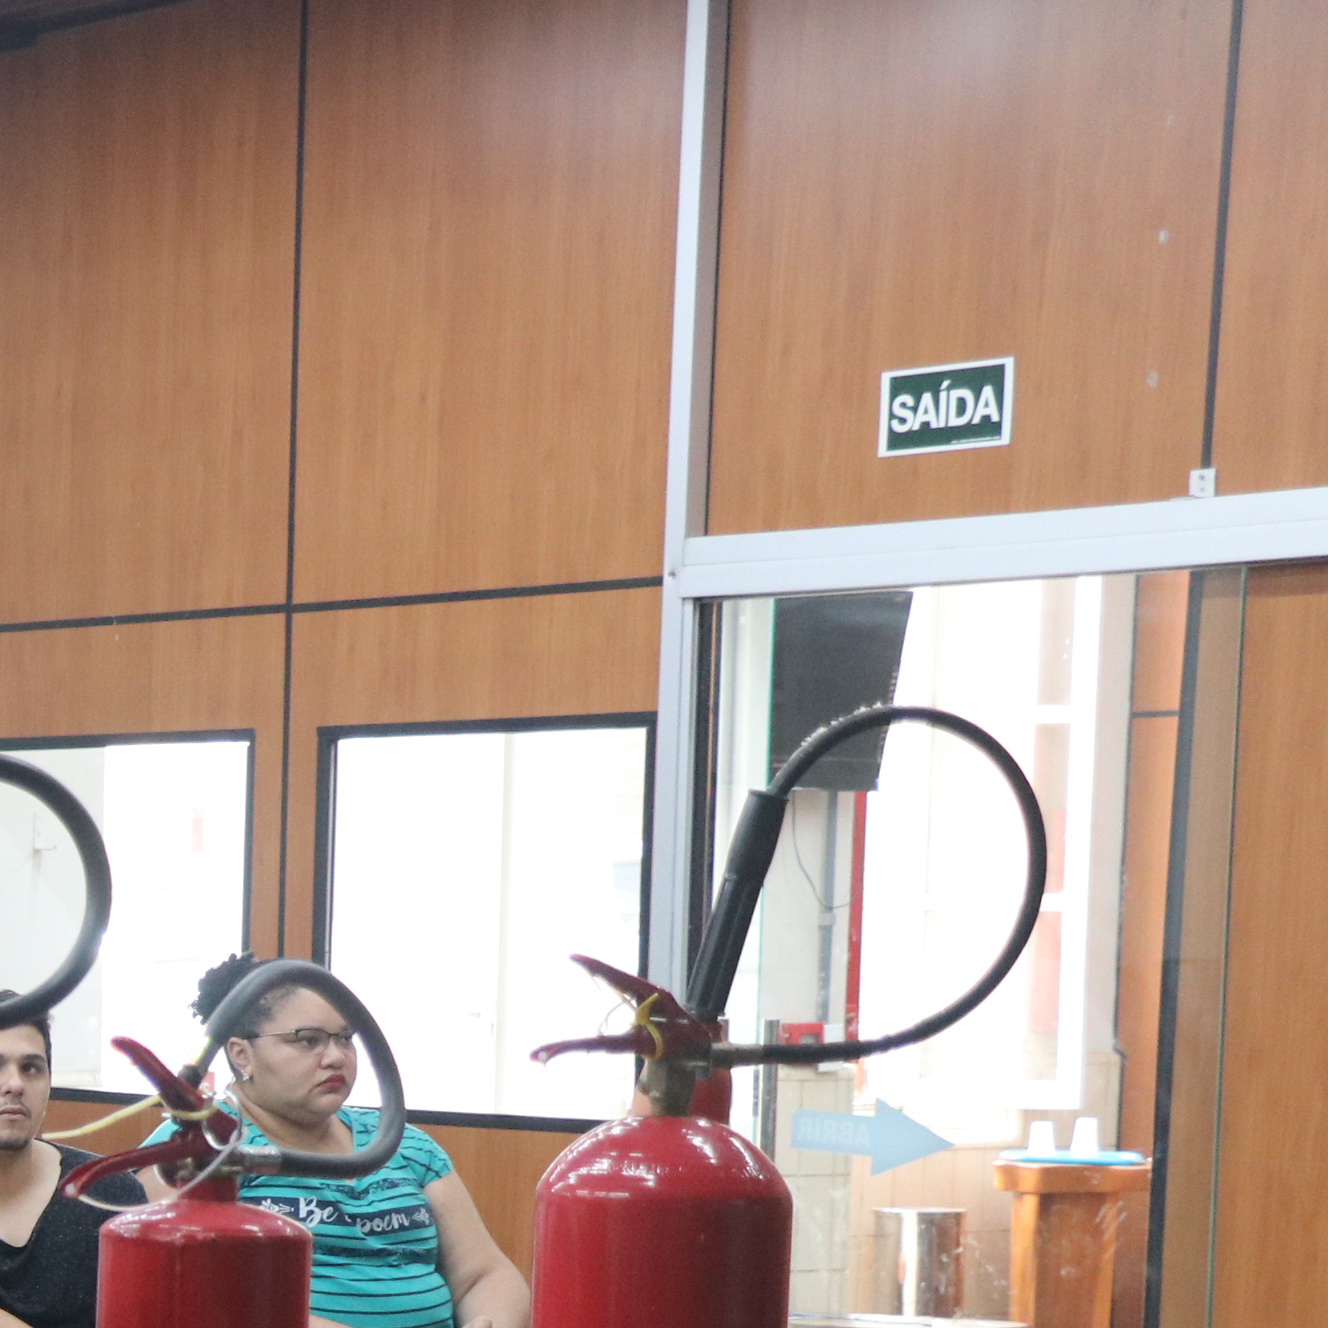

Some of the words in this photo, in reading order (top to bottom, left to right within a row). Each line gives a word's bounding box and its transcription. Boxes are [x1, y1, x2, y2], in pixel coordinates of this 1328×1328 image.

[890, 379, 1000, 434] SAÍDA
[298, 1196, 339, 1228] Be
[356, 1212, 410, 1234] poem
